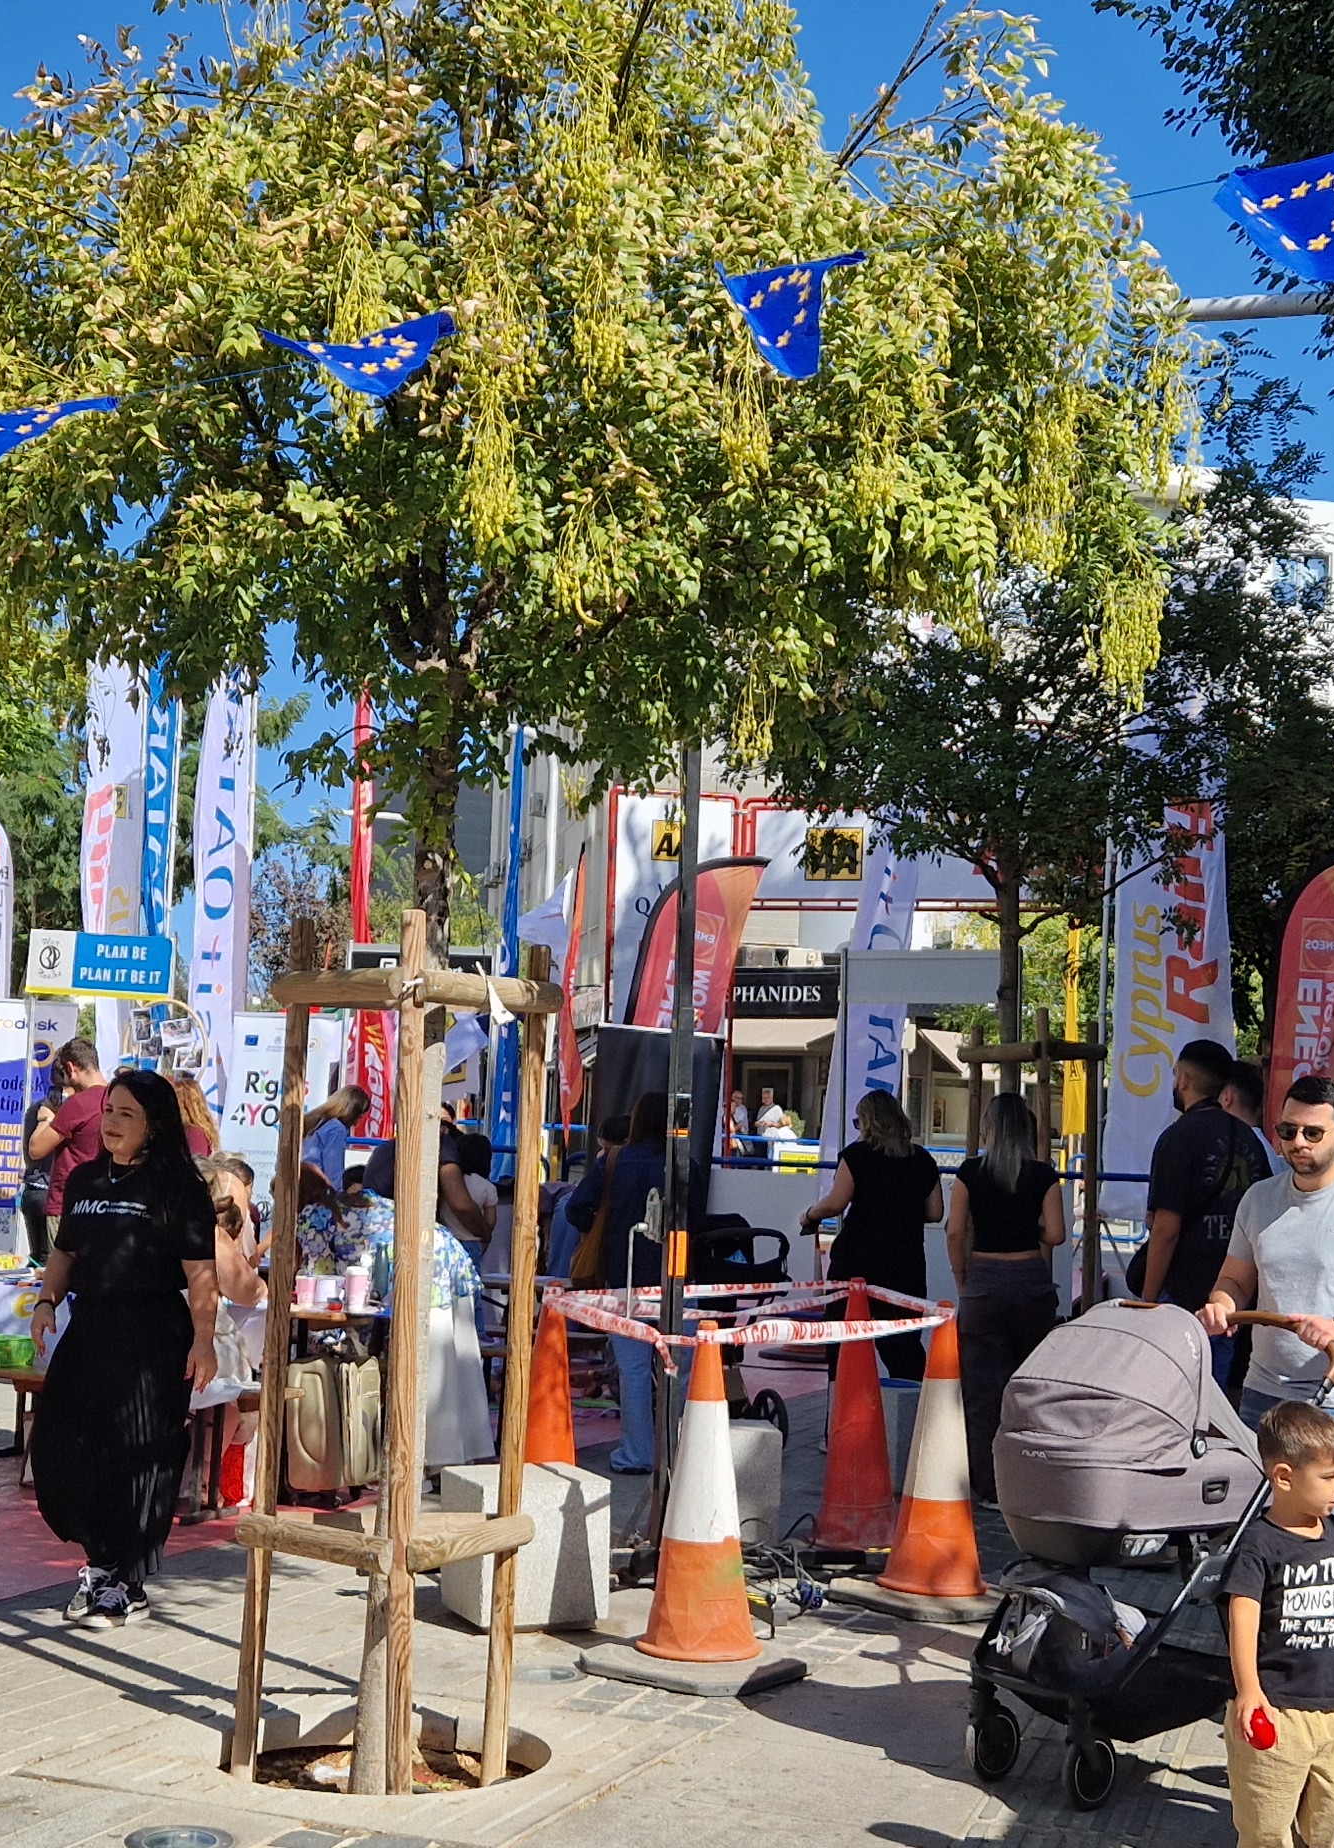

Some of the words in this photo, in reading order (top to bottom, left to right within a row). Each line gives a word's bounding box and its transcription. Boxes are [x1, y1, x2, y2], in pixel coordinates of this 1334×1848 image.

[96, 943, 128, 959] PLAN
[131, 946, 147, 961] BE
[79, 967, 111, 982] PLAN
[114, 968, 127, 983] IT
[130, 969, 146, 985] BE
[148, 970, 161, 985] IT
[733, 986, 821, 1003] PHANIDES
[1119, 900, 1175, 1098] Cyprus
[71, 1199, 109, 1215] MMC
[1283, 1563, 1318, 1587] I'M
[1279, 1618, 1302, 1633] THE
[1285, 1633, 1326, 1650] APPLY
